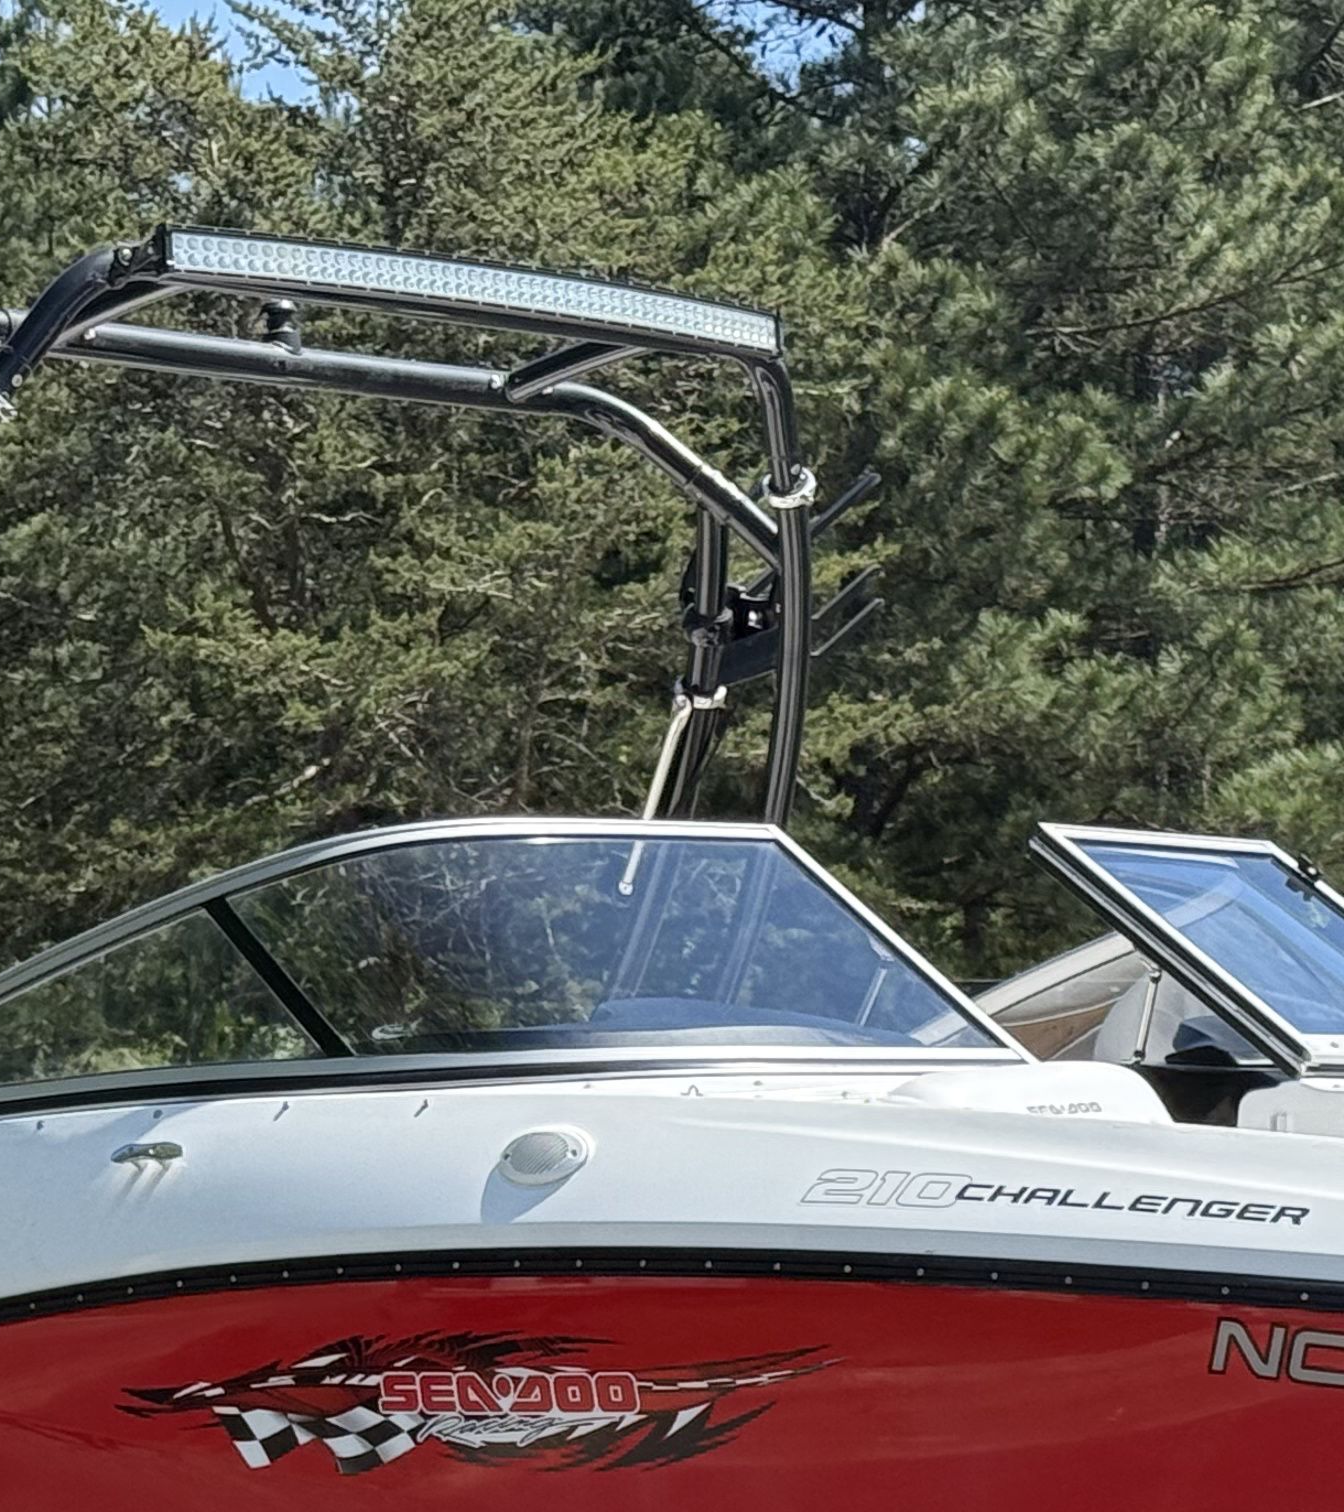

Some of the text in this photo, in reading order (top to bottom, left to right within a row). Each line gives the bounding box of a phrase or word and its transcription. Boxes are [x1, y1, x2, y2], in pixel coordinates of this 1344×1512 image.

[800, 1168, 1310, 1226] 210 CHALLENGER
[417, 1413, 564, 1447] Racing
